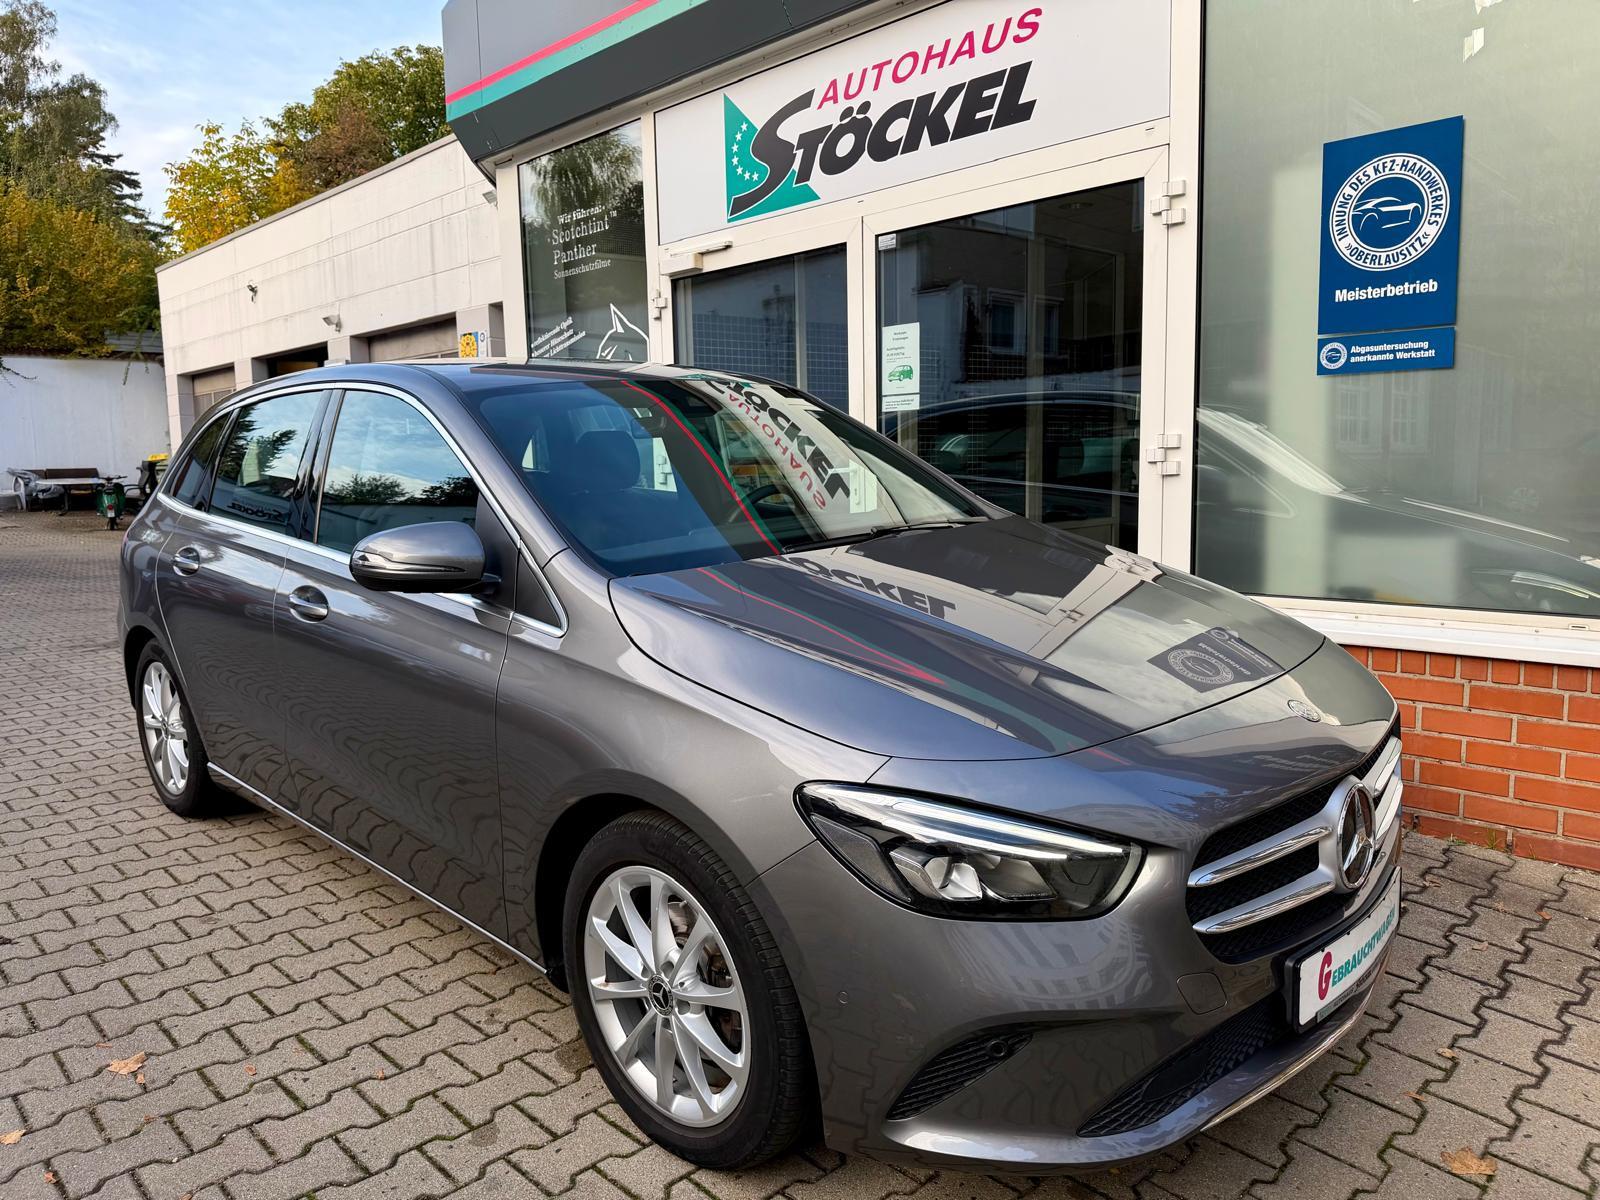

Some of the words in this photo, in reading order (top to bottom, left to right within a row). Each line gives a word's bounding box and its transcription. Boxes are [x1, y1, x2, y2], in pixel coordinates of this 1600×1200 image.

[817, 7, 1043, 110] AUTOHAUS
[728, 61, 1037, 218] STÖCKEL
[1335, 192, 1353, 241] INNUNG
[1349, 170, 1371, 192] DES
[1373, 158, 1444, 227] KFZ-HANDWERKES
[552, 215, 609, 245] Scotchtint
[557, 213, 572, 225] Wir
[553, 244, 597, 264] Panther
[554, 259, 612, 279] Sonnenschutzfilme
[1335, 279, 1438, 302] Meisterbetrieb
[1350, 353, 1394, 363] anerkannte
[1396, 349, 1435, 359] Werkstatt
[1351, 341, 1429, 353] Abgasuntersuchung
[1318, 904, 1396, 1000] GEBRAUCHTWAGEN
